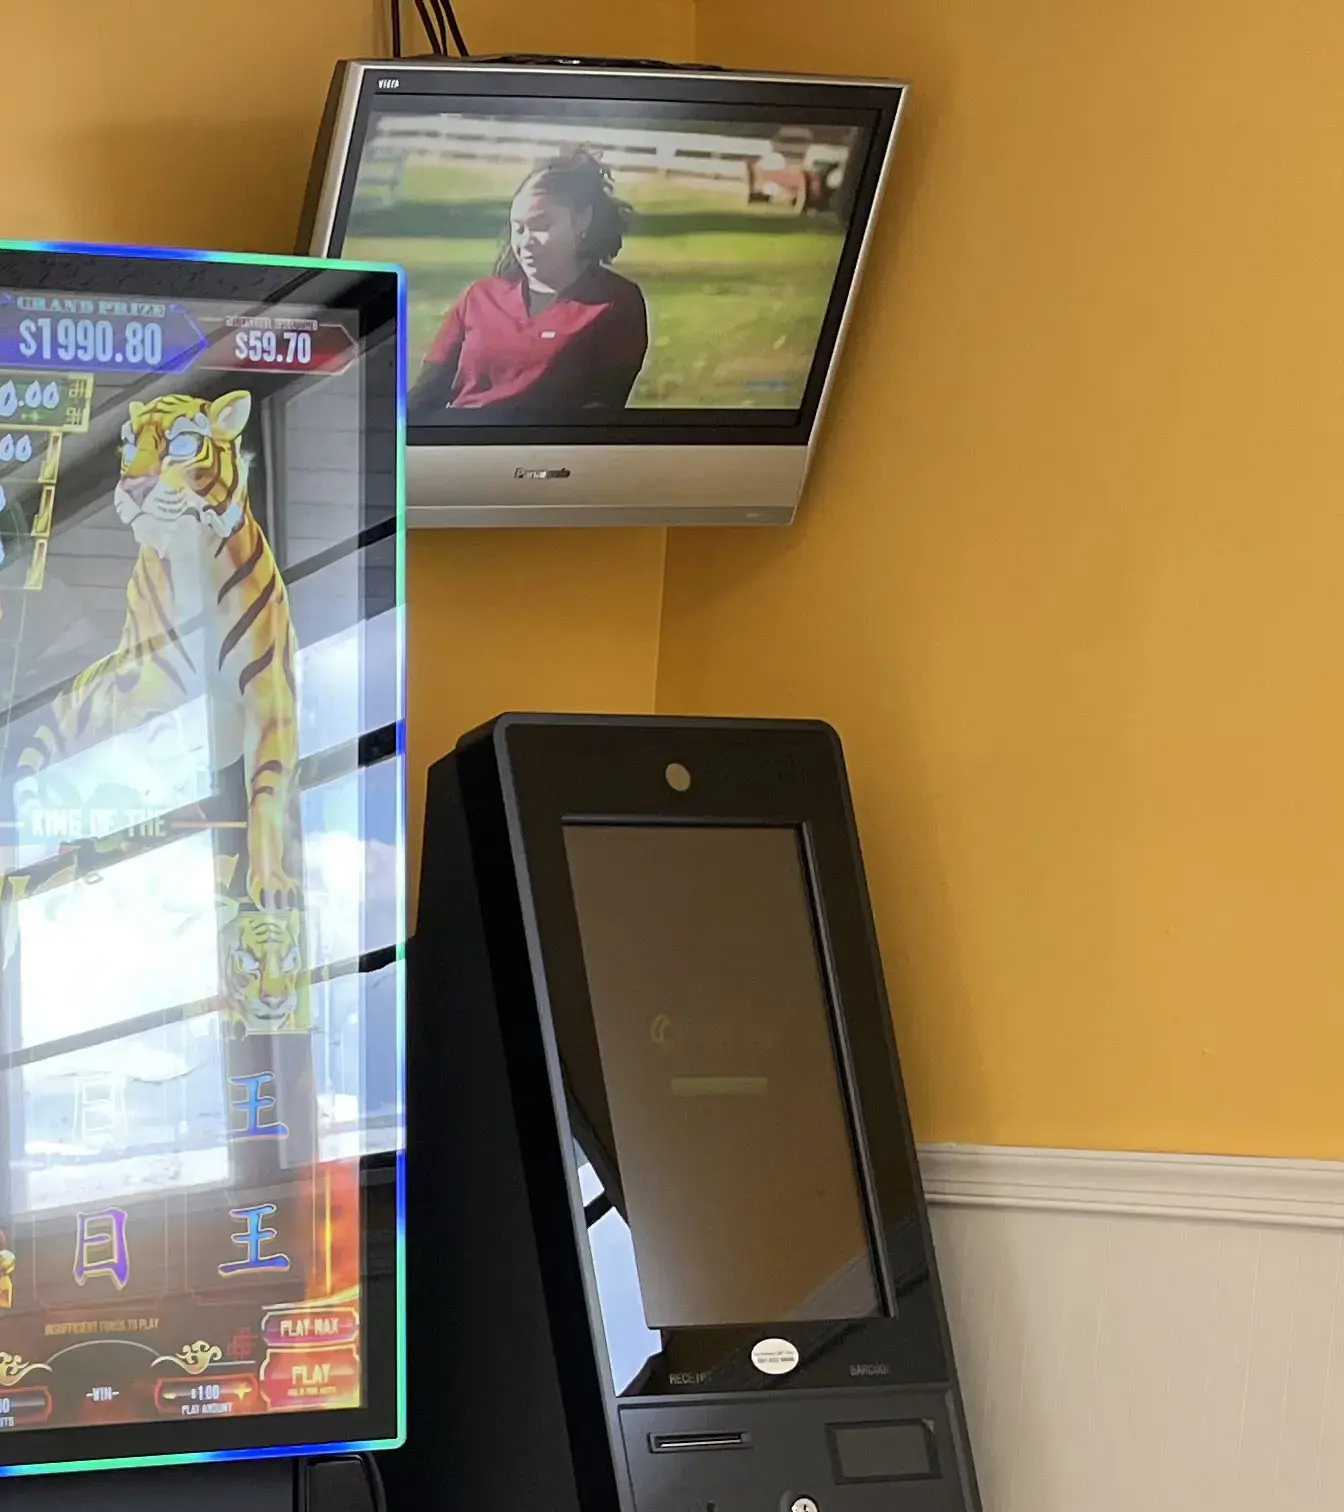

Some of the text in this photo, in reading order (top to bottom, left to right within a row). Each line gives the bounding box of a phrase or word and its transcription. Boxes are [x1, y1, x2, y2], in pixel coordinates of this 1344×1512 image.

[15, 296, 166, 318] GRAND PRIZE
[18, 317, 163, 365] $1990.80
[234, 330, 312, 364] $59.70
[138, 1317, 160, 1331] PLAY
[280, 1318, 311, 1337] PLAY
[291, 1363, 331, 1385] PLAY
[181, 1404, 200, 1415] PLAY
